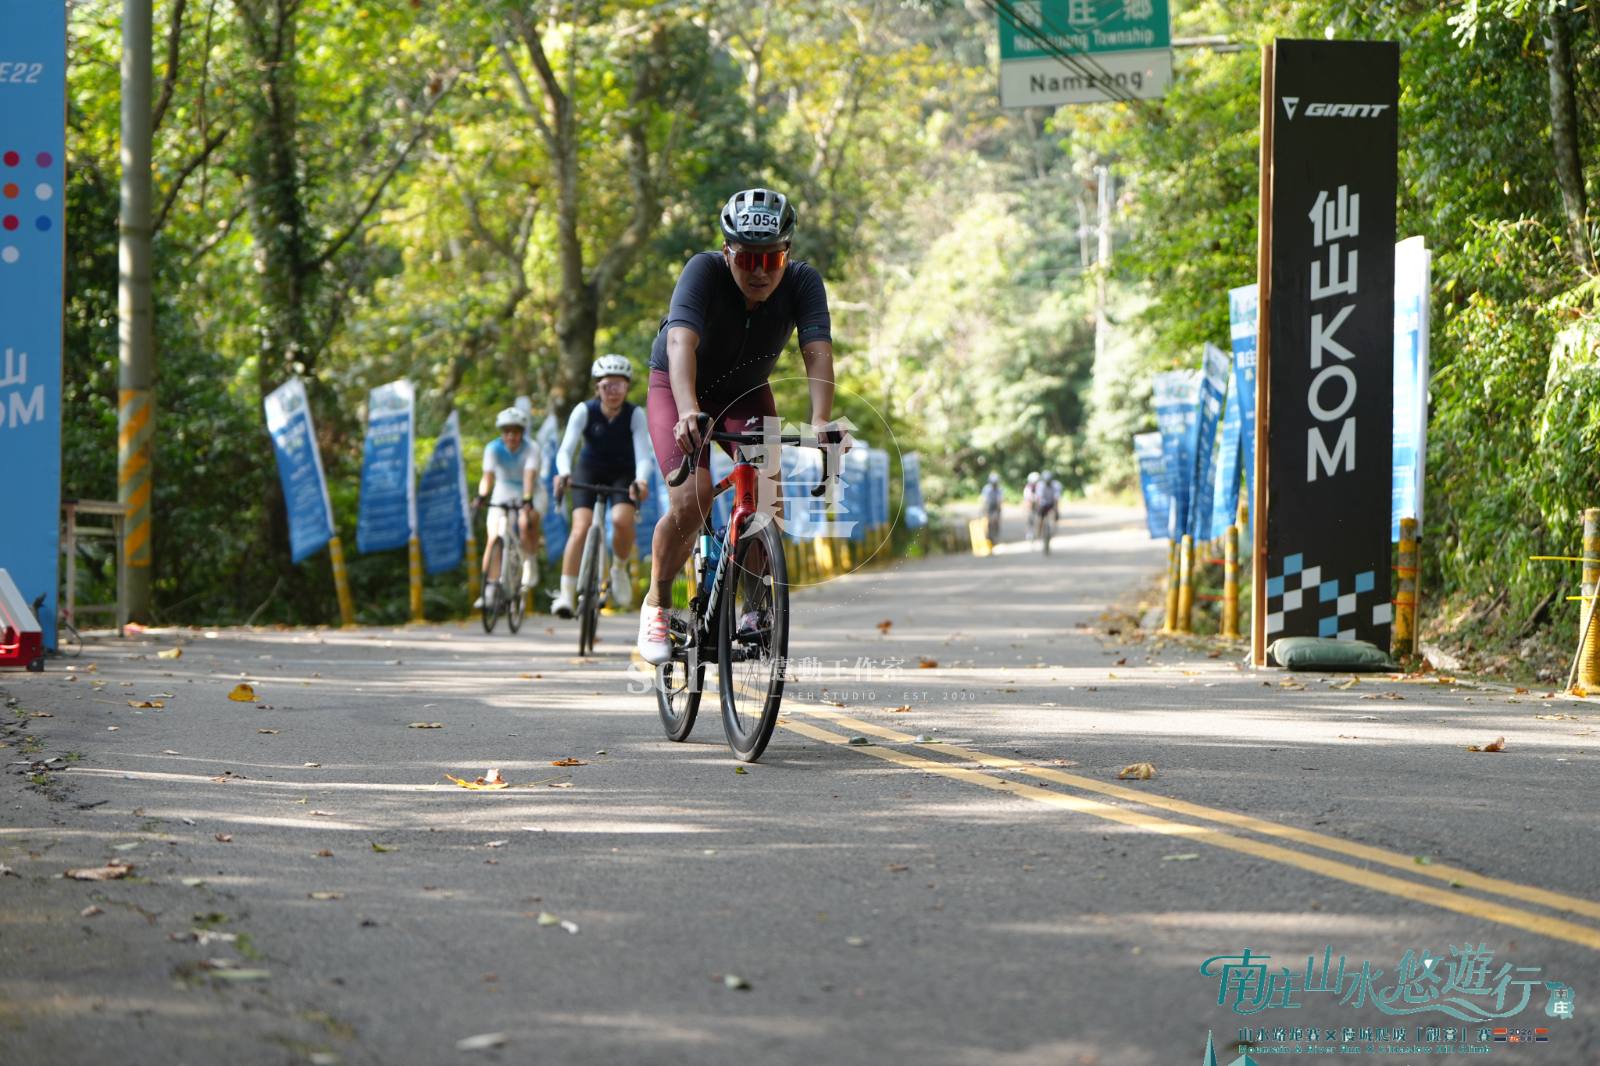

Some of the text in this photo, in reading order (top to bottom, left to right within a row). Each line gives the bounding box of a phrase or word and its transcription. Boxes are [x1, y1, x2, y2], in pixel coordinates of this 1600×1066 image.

[1093, 28, 1154, 45] Township
[1303, 102, 1391, 118] GIANT
[741, 213, 779, 228] 2054
[0, 383, 44, 429] M
